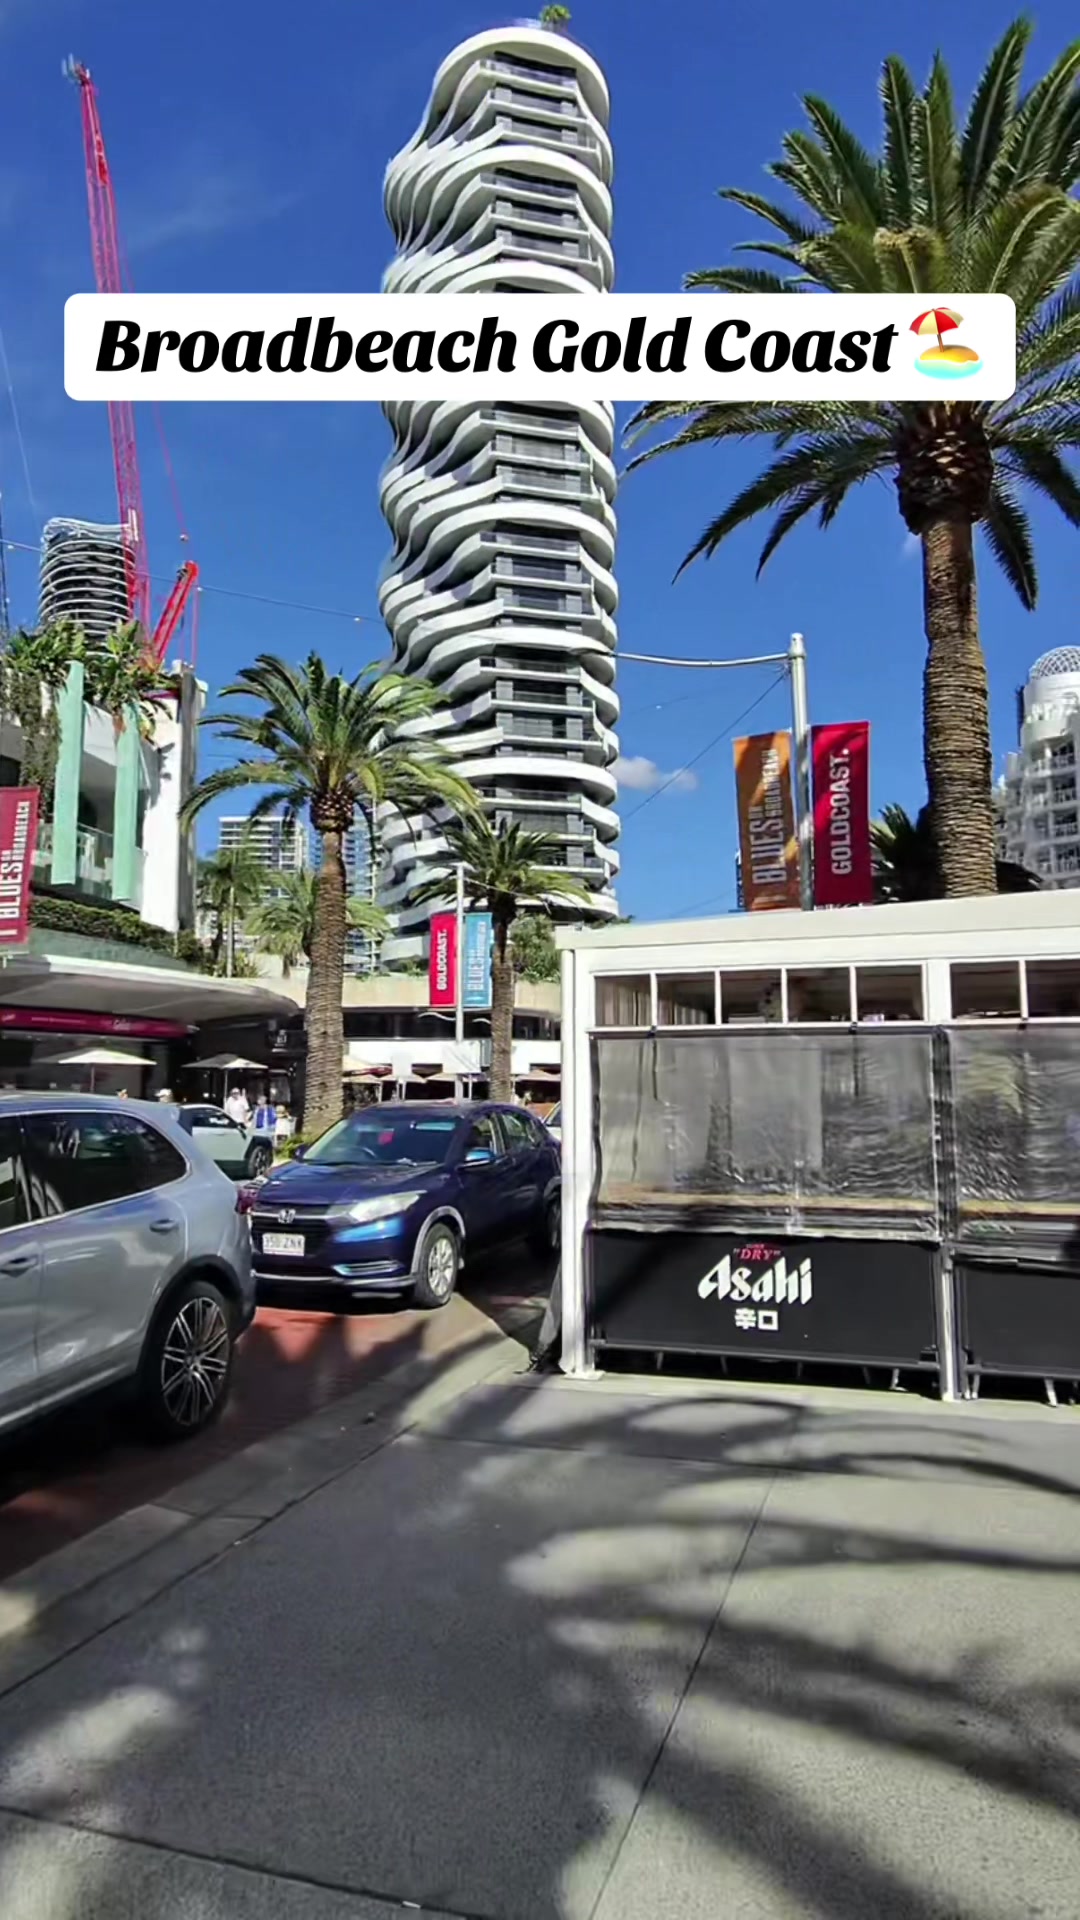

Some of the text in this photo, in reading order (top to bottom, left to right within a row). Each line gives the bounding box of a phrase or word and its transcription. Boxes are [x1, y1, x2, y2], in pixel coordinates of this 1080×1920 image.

[829, 748, 852, 875] GOLDCOAST.
[750, 818, 787, 884] BLUES
[0, 862, 23, 918] BLUES
[698, 1254, 812, 1304] Asahi
[734, 1307, 779, 1331] 辛口
